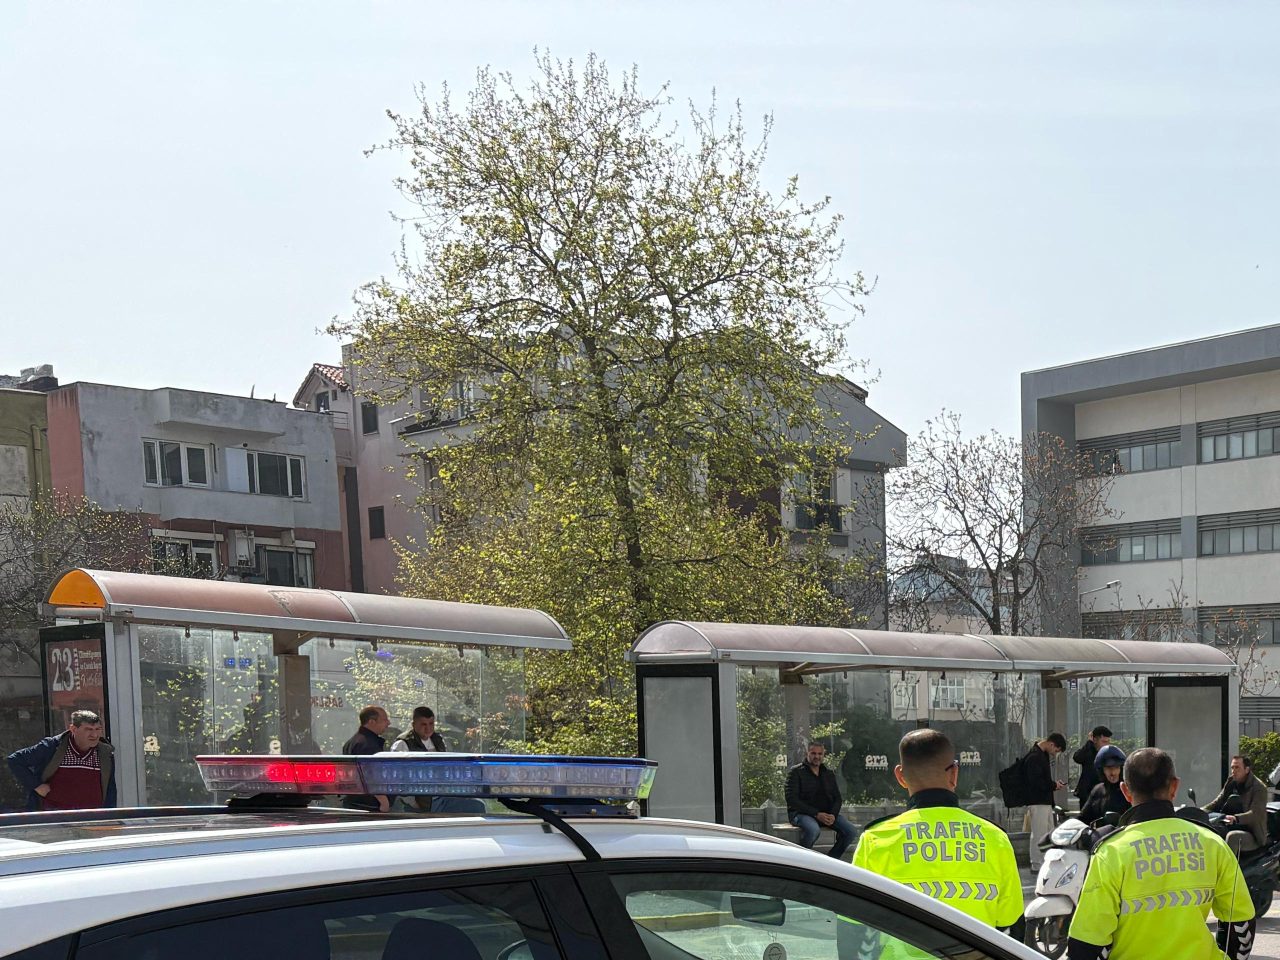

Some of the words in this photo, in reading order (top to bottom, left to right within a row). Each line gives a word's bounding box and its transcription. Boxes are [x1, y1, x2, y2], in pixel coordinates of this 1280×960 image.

[51, 647, 75, 692] 23
[865, 754, 889, 765] era
[959, 750, 982, 762] era
[900, 820, 985, 841] TRAFİK
[902, 840, 986, 864] POLİSİ
[1129, 831, 1204, 859] TRAFİK
[1134, 850, 1206, 880] POLİSİ
